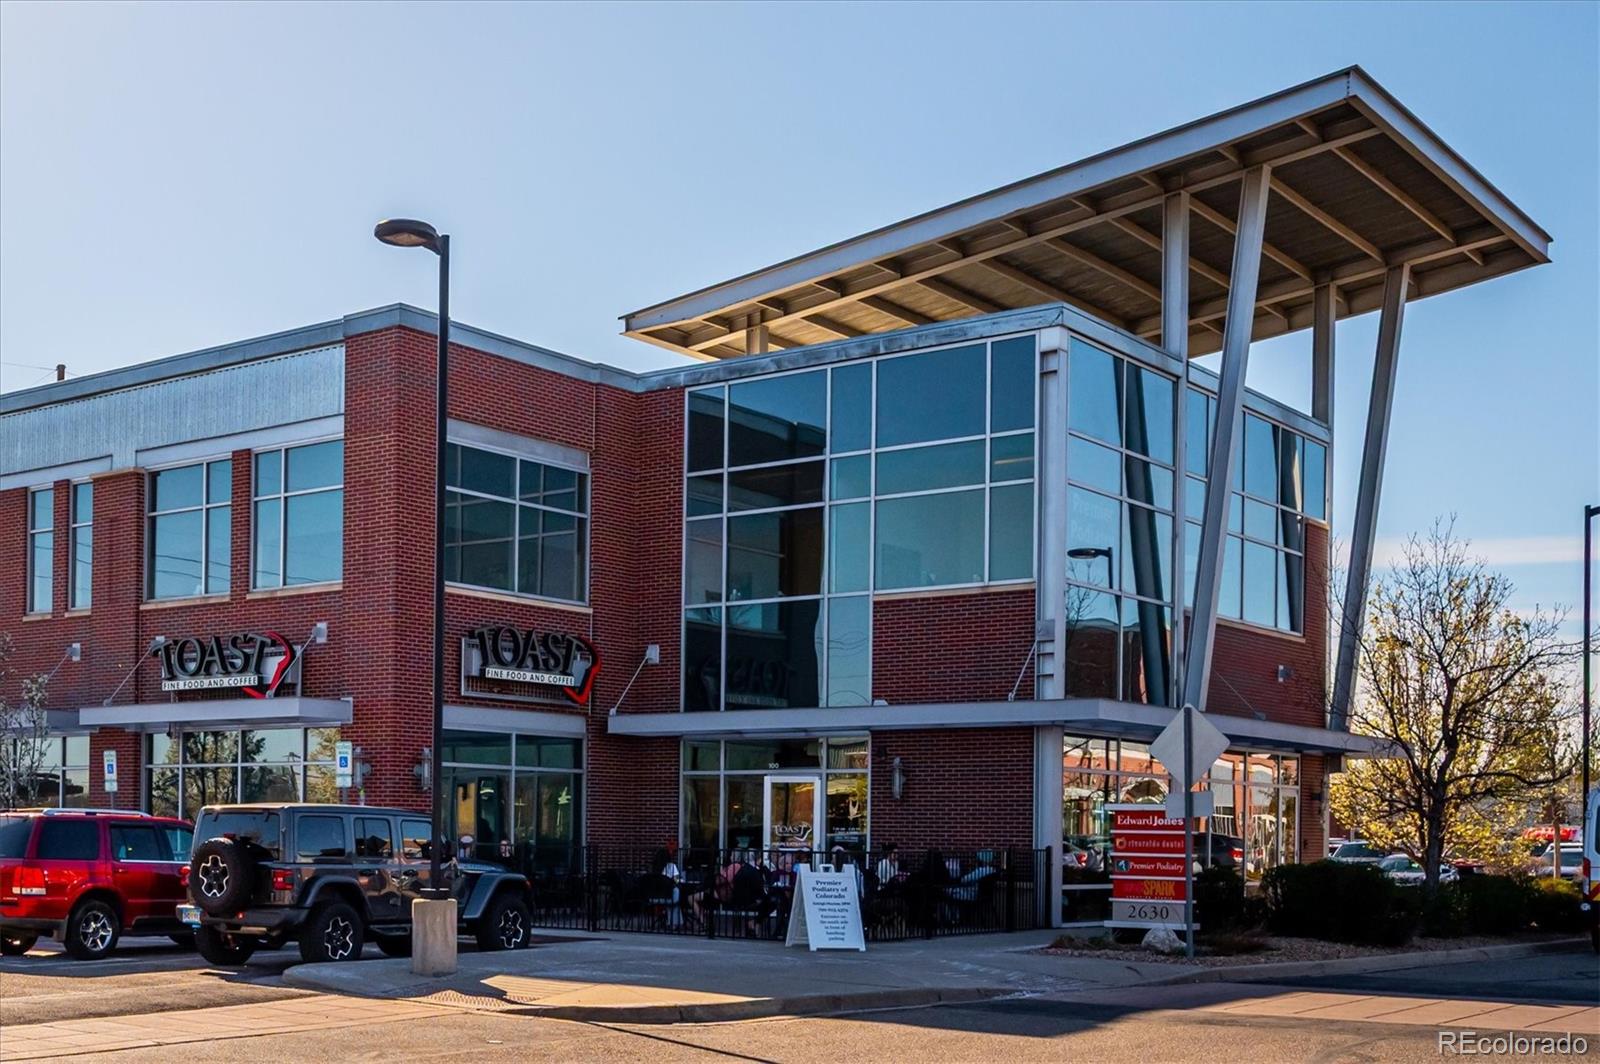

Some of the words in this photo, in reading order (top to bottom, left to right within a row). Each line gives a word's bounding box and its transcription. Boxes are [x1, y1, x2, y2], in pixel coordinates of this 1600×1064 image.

[152, 632, 272, 680] TOAST
[473, 625, 588, 675] TOAST
[163, 680, 180, 690] FINE
[183, 679, 205, 689] FOOD
[207, 678, 225, 687] AND
[227, 676, 258, 686] COFFEE
[487, 668, 504, 678] FINE
[506, 670, 527, 681] FOOD
[529, 672, 545, 682] AND
[547, 675, 574, 686] COFFEE
[1117, 815, 1153, 825] Edward
[1153, 815, 1185, 826] Jones
[772, 823, 807, 836] TOAST
[1129, 861, 1155, 870] Premier
[1156, 861, 1185, 873] Podiatry
[1143, 880, 1176, 897] SPARK
[1127, 904, 1170, 920] 2630
